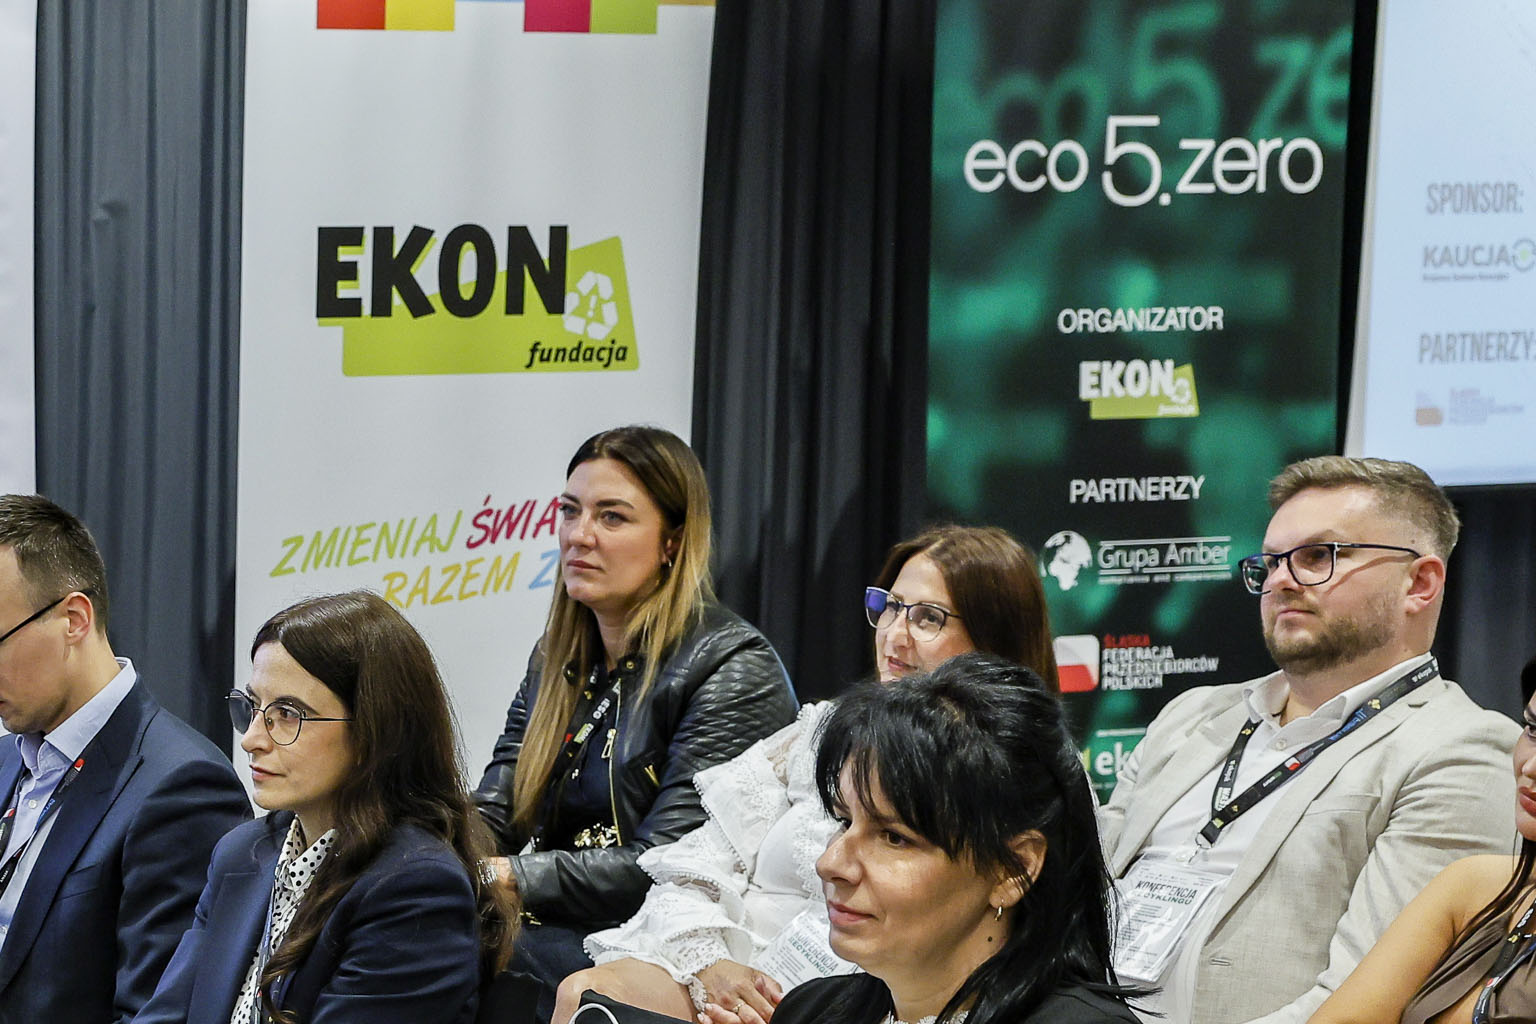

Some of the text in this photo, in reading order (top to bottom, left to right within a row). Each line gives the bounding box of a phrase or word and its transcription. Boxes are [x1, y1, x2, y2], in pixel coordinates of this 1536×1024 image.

[1425, 180, 1524, 215] SPONSOR:
[315, 223, 569, 319] EKON
[1057, 306, 1224, 334] ORGANIZATOR
[524, 339, 629, 369] fundacja
[1079, 358, 1175, 399] EKON
[1069, 474, 1206, 504] PARTNERZY
[269, 494, 562, 578] ZMIENIAJ ŚWIA
[1097, 541, 1232, 573] Grupa Amber
[383, 551, 521, 609] RAZEM
